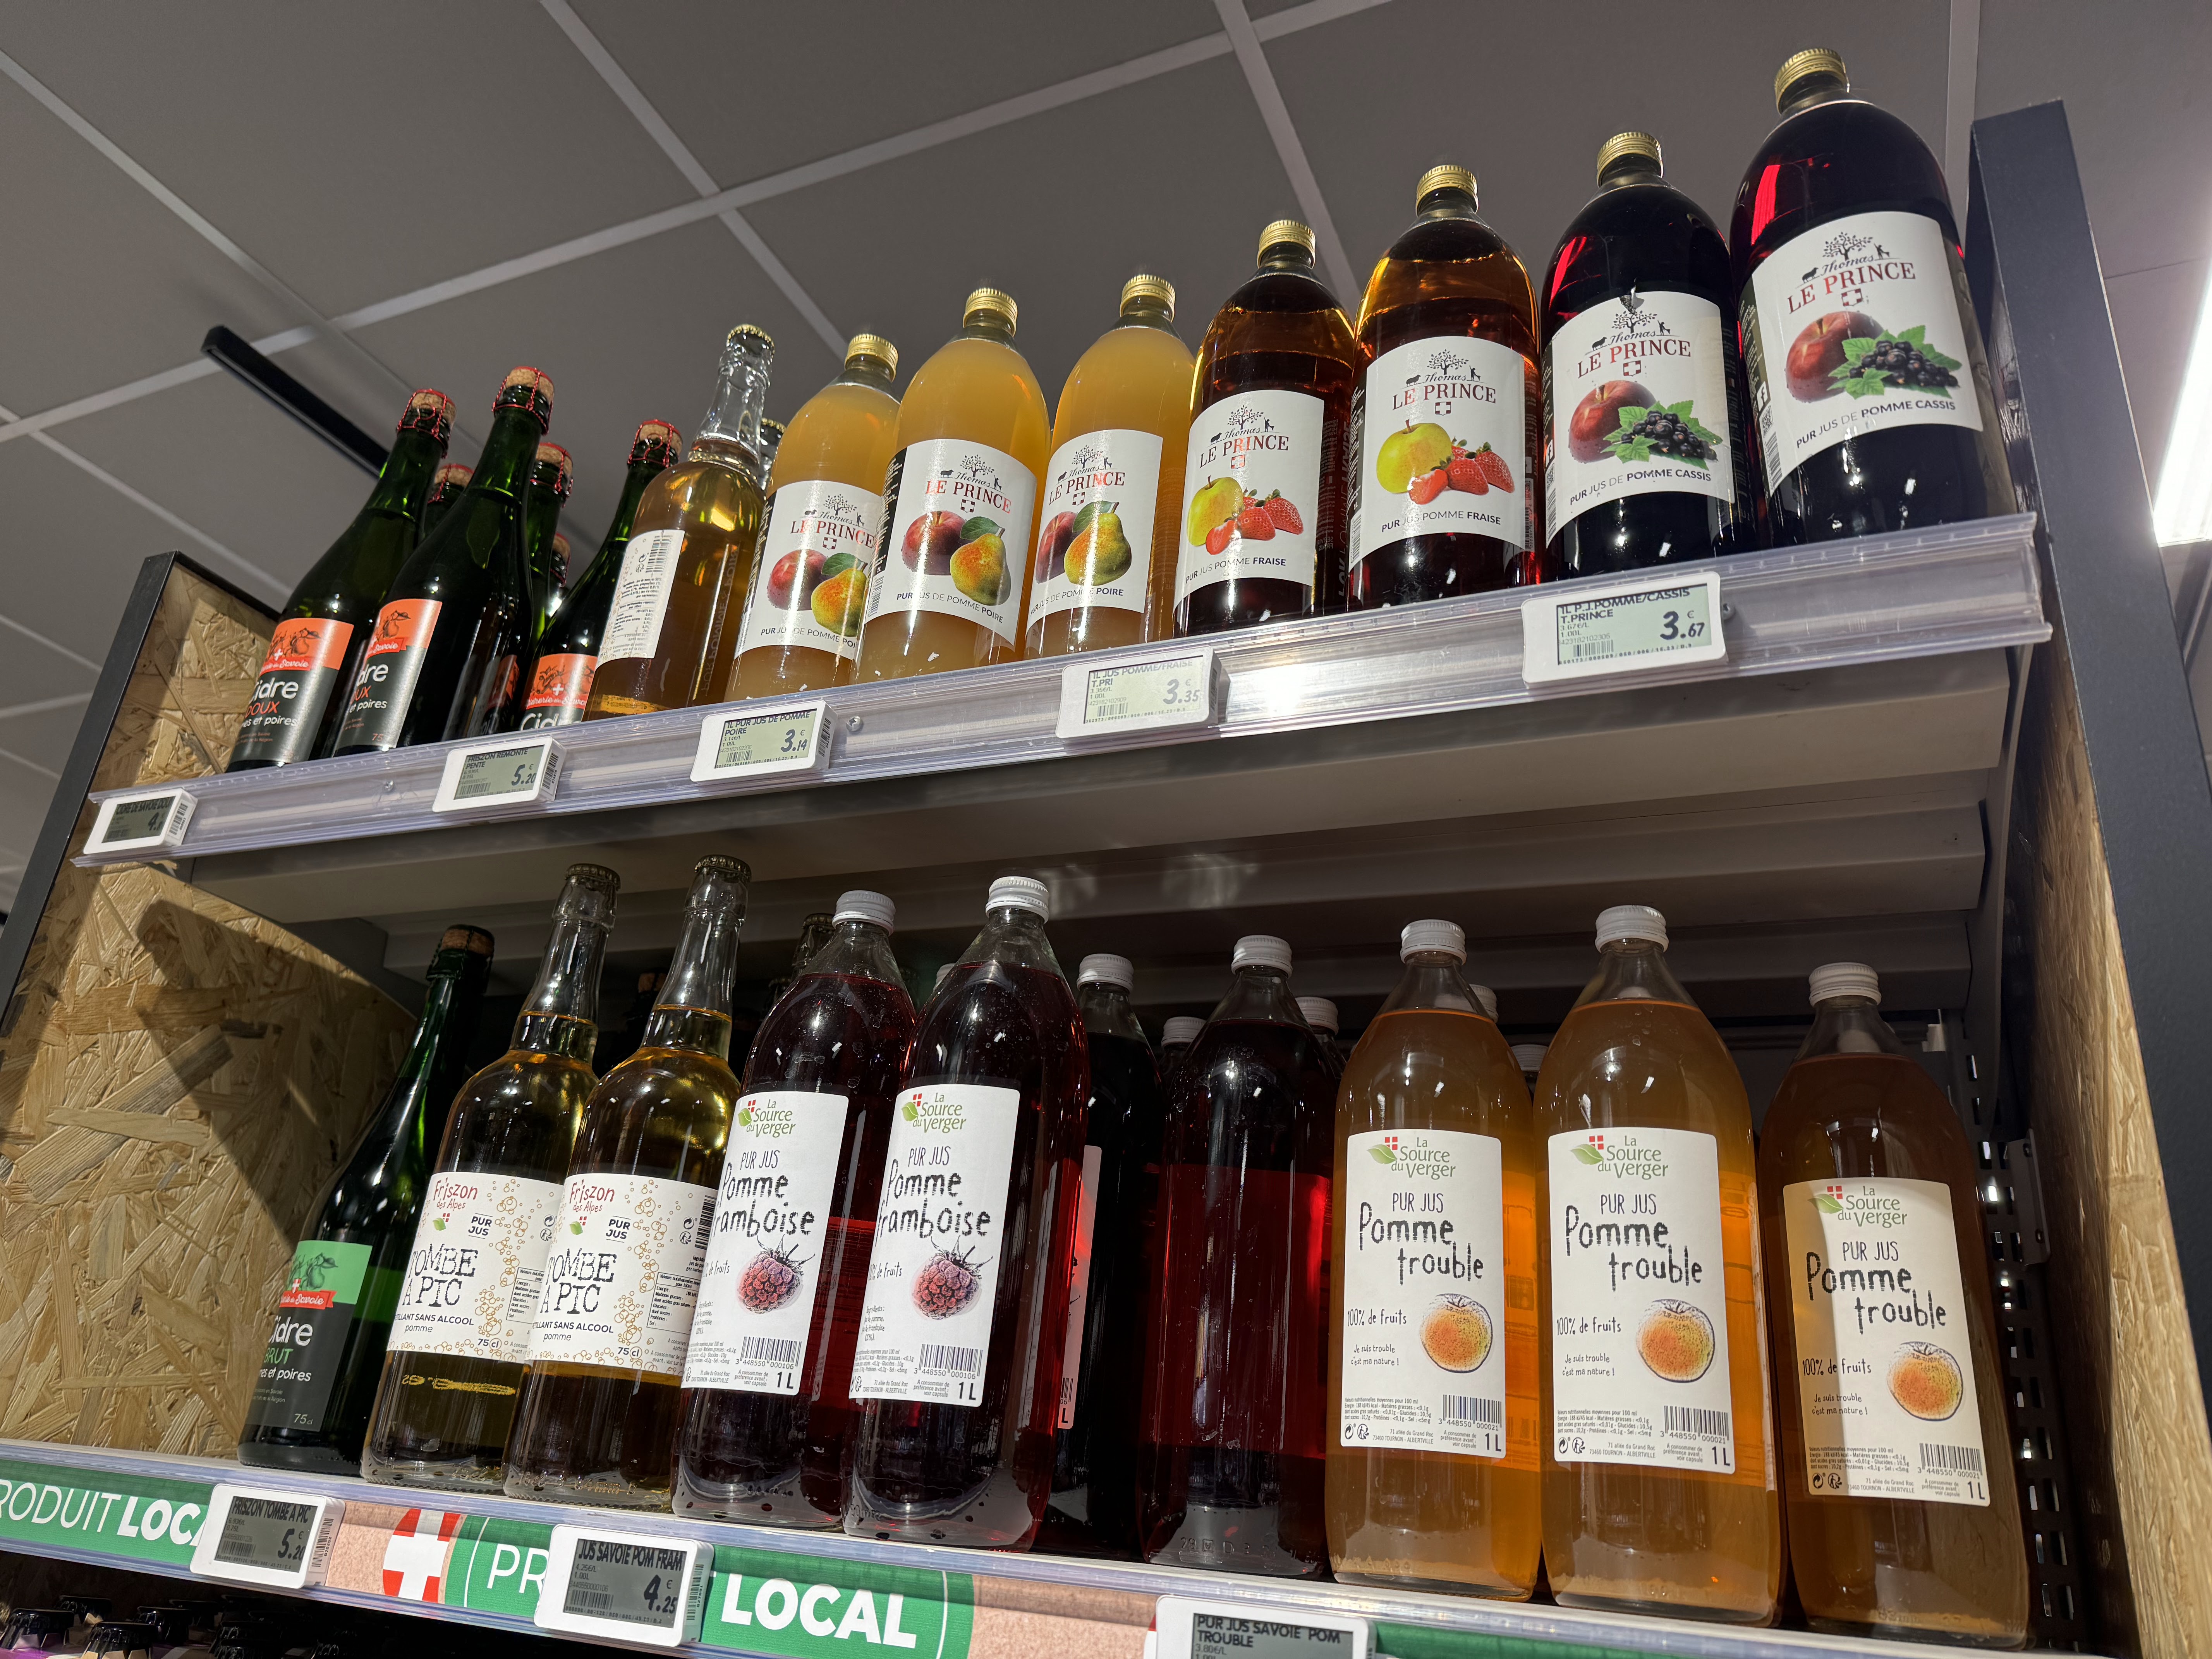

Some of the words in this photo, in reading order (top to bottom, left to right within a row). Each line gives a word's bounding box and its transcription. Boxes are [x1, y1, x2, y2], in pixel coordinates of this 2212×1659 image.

[1820, 254, 1874, 276] Thomas
[1788, 284, 1815, 314] LE
[1824, 263, 1916, 295] PRINCE
[1608, 330, 1656, 346] Thomas
[1577, 353, 1601, 379] LE
[1611, 340, 1691, 363] PRINCE
[1422, 372, 1467, 384] Thomas
[1392, 388, 1415, 410] LE
[1424, 383, 1496, 404] PRINCE
[1797, 430, 1817, 448] PUR
[1861, 401, 1913, 418] POMME
[1916, 400, 1956, 410] CASSIS
[1223, 426, 1261, 441] Thomas
[1200, 446, 1217, 468] LE
[1223, 435, 1289, 457] PRINCE
[954, 472, 991, 487] Thomas
[1570, 489, 1587, 505] PUR
[1589, 480, 1606, 496] JUS
[1609, 474, 1623, 486] DE
[1627, 469, 1672, 482] POMME
[1675, 469, 1711, 482] CASSIS
[926, 480, 947, 494] LE
[953, 481, 1012, 514] PRINCE
[1049, 485, 1062, 506] LE
[1066, 472, 1125, 494] PRINCE
[817, 512, 852, 524] Thomas
[1382, 519, 1400, 532] PUR
[1423, 511, 1463, 520] POMME
[1467, 512, 1501, 525] FRAISE
[816, 520, 874, 548] PRINCE
[1186, 570, 1198, 584] PUR
[1199, 564, 1212, 575] JUS
[1253, 557, 1286, 566] FRAISE
[947, 595, 980, 611] POMME
[981, 607, 1003, 623] POIRE
[1561, 609, 1614, 623] T.PRINCE
[807, 629, 840, 642] POMME
[1103, 669, 1119, 678] JUS
[1122, 661, 1193, 675] POMME/FRAISE
[1092, 678, 1113, 687] T.PRI
[357, 699, 388, 712] poires
[264, 716, 298, 726] poires
[752, 716, 766, 725] JUS
[780, 712, 810, 721] POMME
[725, 727, 747, 736] POIRE
[468, 752, 495, 762] FRISZON
[767, 1099, 776, 1109] La
[935, 1092, 945, 1103] La
[753, 1108, 793, 1122] Source
[920, 1102, 962, 1116] Source
[747, 1122, 754, 1132] du
[756, 1123, 796, 1138] Verger
[913, 1116, 922, 1127] du
[924, 1117, 967, 1133] Verger
[1417, 1137, 1427, 1147] La
[1625, 1135, 1637, 1146] La
[740, 1150, 757, 1170] PUR
[759, 1149, 780, 1169] JUS
[908, 1147, 926, 1167] PUR
[929, 1146, 951, 1166] JUS
[1400, 1146, 1450, 1163] Source
[1607, 1145, 1661, 1161] Source
[1391, 1161, 1403, 1171] du
[1406, 1163, 1456, 1180] Verger
[1598, 1161, 1611, 1172] du
[1614, 1163, 1668, 1180] Verger
[433, 1177, 478, 1201] Friszon
[570, 1178, 615, 1202] Friszon
[719, 1162, 789, 1208] Pomme
[885, 1158, 962, 1207] Pomme
[1863, 1185, 1875, 1196] La
[437, 1199, 446, 1209] des
[447, 1201, 466, 1211] Alpes
[1393, 1192, 1414, 1212] PUR
[1420, 1193, 1444, 1213] JUS
[1601, 1193, 1625, 1214] PUR
[1632, 1194, 1656, 1215] JUS
[1846, 1195, 1900, 1211] Source
[471, 1216, 492, 1227] PUR
[609, 1219, 630, 1230] PUR
[875, 1197, 991, 1247] framboise
[1359, 1202, 1454, 1251] Pomme
[1838, 1210, 1851, 1220] du
[1854, 1212, 1907, 1228] Verger
[468, 1226, 489, 1236] JUS
[606, 1228, 627, 1240] JUS
[1566, 1205, 1669, 1256] Pomme
[1843, 1241, 1867, 1261] PUR
[1874, 1241, 1898, 1261] JUS
[408, 1243, 479, 1279] TOMBE
[546, 1248, 617, 1285] TOMBE
[1396, 1241, 1484, 1285] trouble
[1608, 1243, 1702, 1292] trouble
[1806, 1252, 1912, 1301] Pomme
[295, 1293, 325, 1305] Savoie
[415, 1276, 463, 1307] PIC
[554, 1282, 601, 1314] PIC
[415, 1314, 435, 1322] SANS
[437, 1315, 474, 1326] ALCOOL
[1348, 1309, 1365, 1326] 100%
[1368, 1310, 1376, 1324] de
[1381, 1309, 1407, 1325] fruits
[1855, 1289, 1946, 1335] trouble
[405, 1325, 433, 1333] pomme
[477, 1338, 489, 1347] 75
[1354, 1345, 1360, 1353] Je
[1373, 1344, 1395, 1353] trouble
[263, 1347, 294, 1364] BRUT
[1351, 1356, 1361, 1366] c'est
[276, 1368, 312, 1382] poires
[921, 1369, 946, 1377] 448550
[951, 1370, 976, 1379] 000106
[1446, 1419, 1472, 1428] 448550
[1476, 1422, 1499, 1431] 000021
[232, 1499, 264, 1518] FRISZON
[295, 1507, 311, 1523] PIC
[578, 1540, 597, 1560] JUS
[596, 1541, 630, 1565] SAVOIE
[631, 1547, 654, 1568] POM
[656, 1551, 683, 1571] FRAM
[721, 1573, 917, 1650] LOCAL
[1197, 1616, 1223, 1630] PUR
[1226, 1619, 1250, 1633] JUS
[1253, 1621, 1301, 1640] SAVOIE
[1308, 1628, 1341, 1644] POM
[1197, 1630, 1254, 1648] TROUBLE
